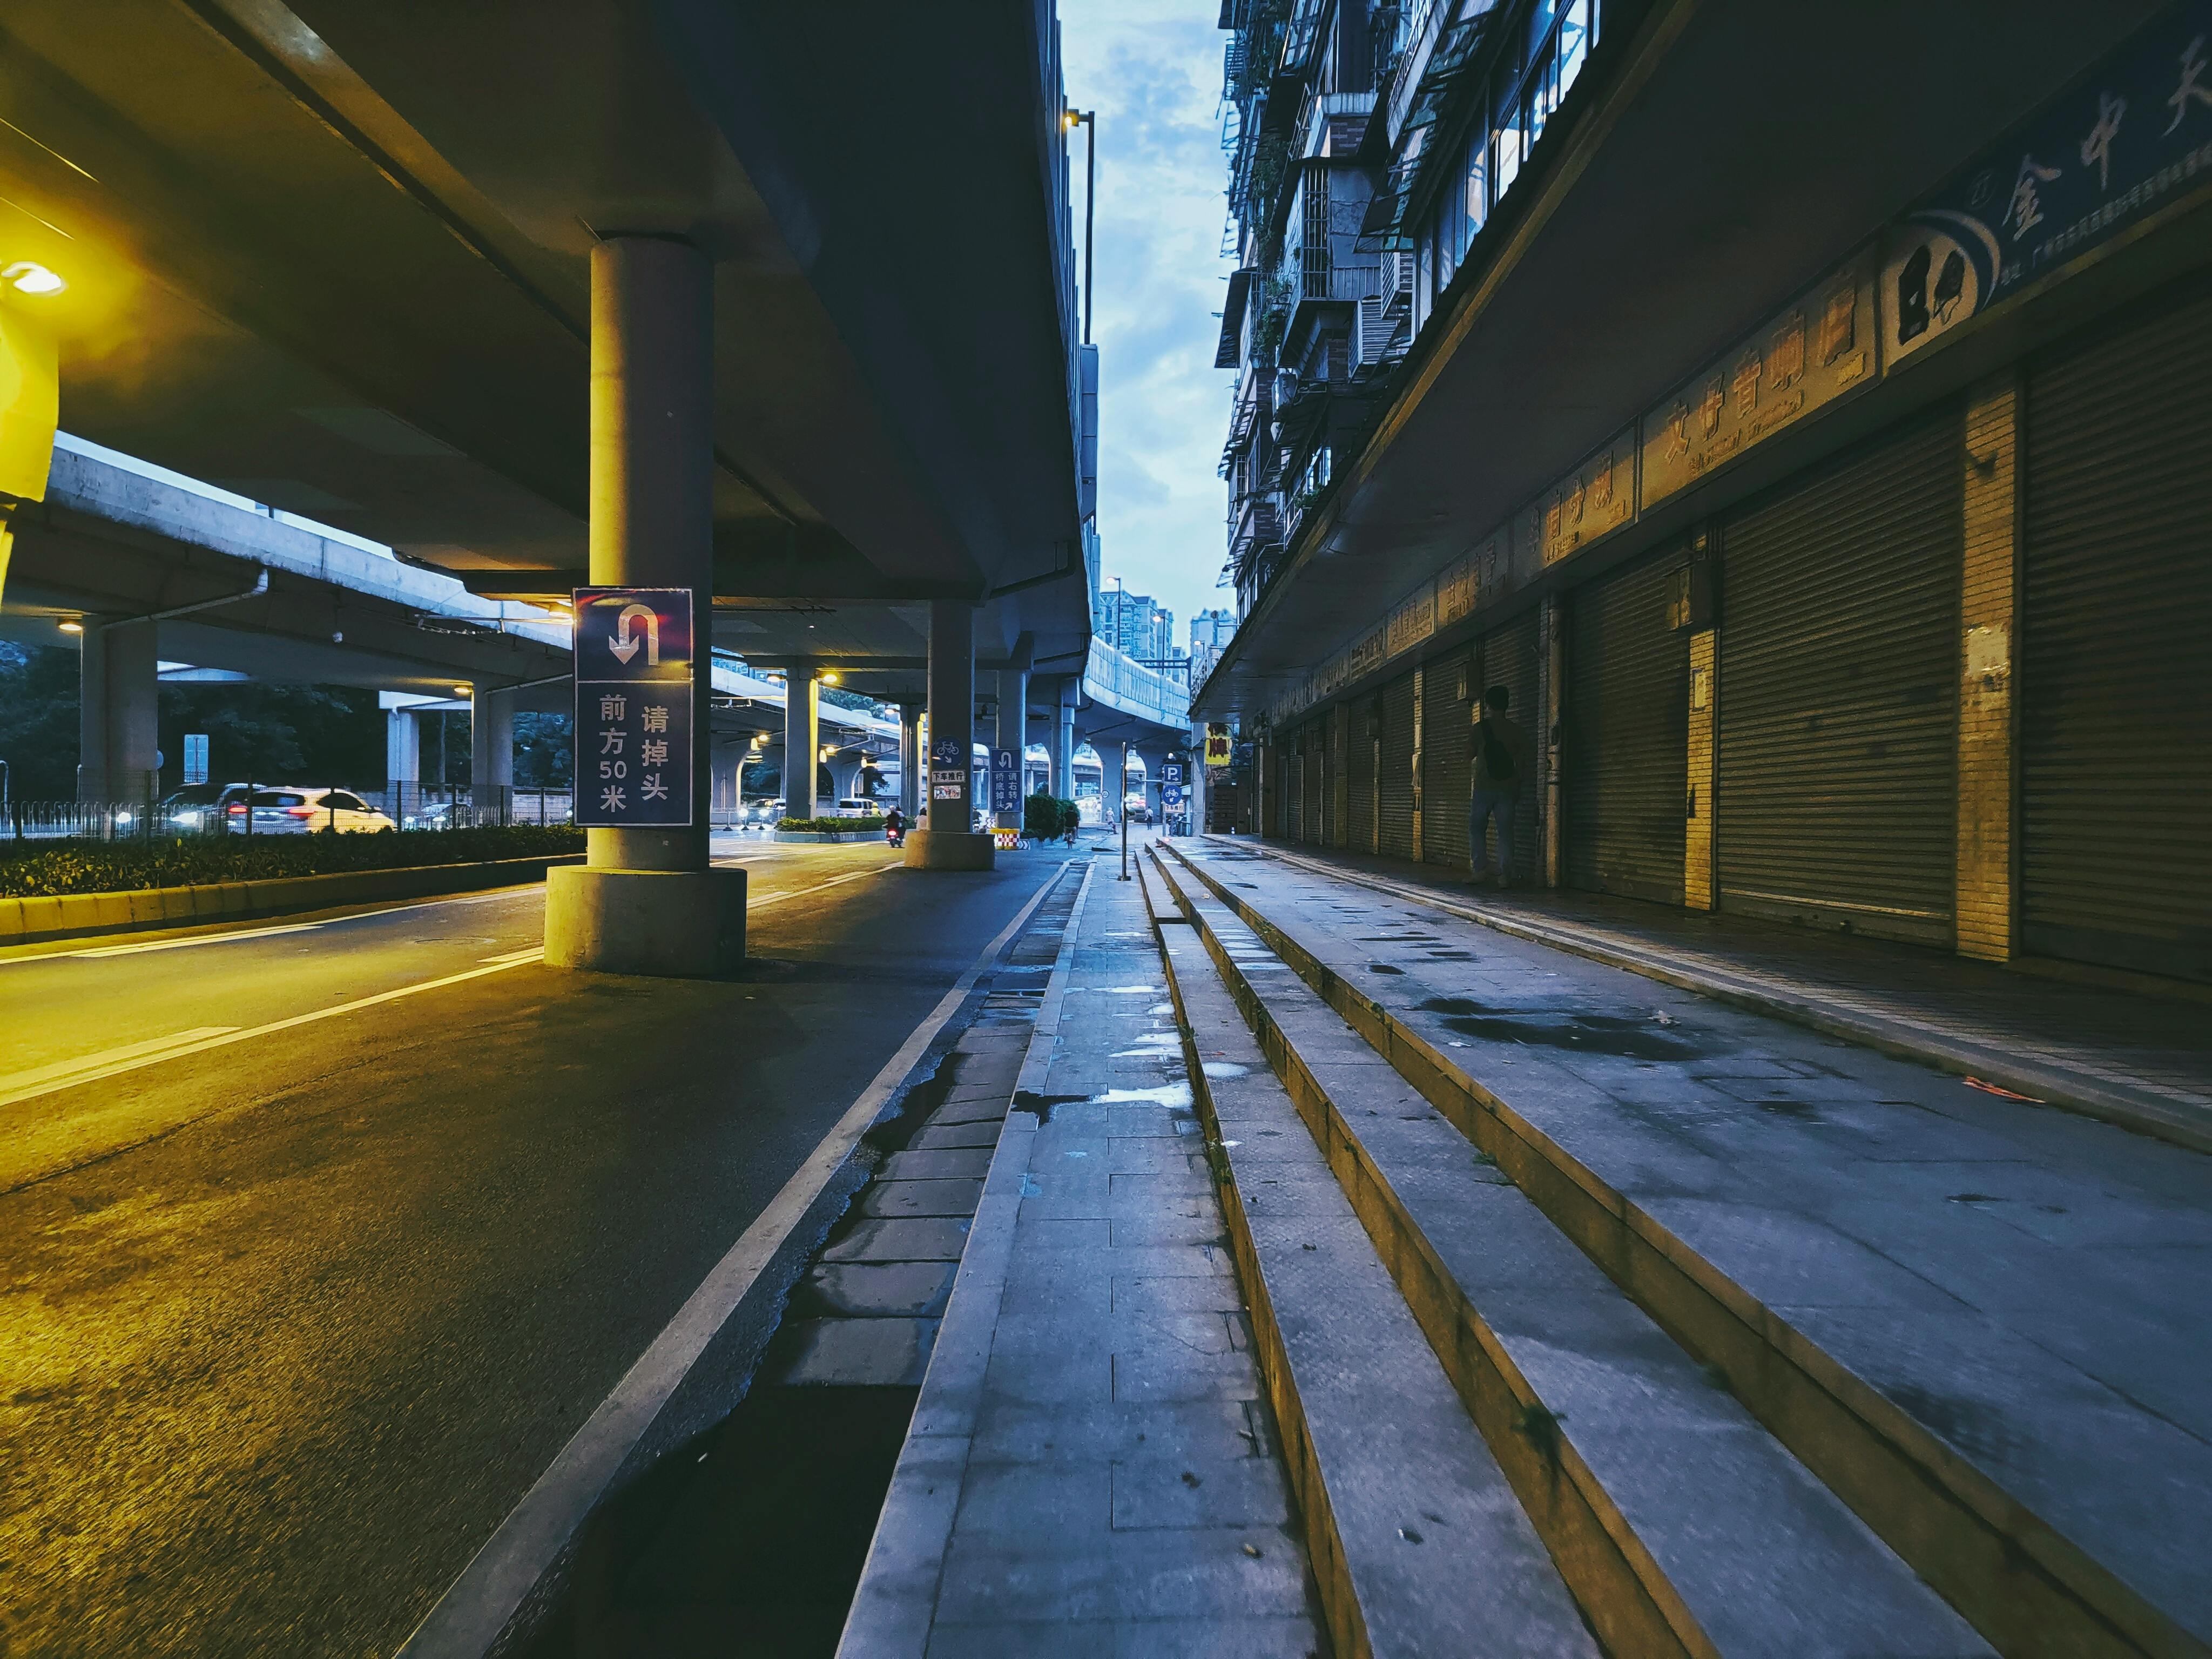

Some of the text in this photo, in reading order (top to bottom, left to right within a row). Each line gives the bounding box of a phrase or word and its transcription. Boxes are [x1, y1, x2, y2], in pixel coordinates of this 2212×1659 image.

[599, 694, 628, 813] 前方50米
[641, 705, 669, 801] 请掉头
[933, 772, 963, 781] 下车推行
[1008, 773, 1017, 799] 请右转
[1168, 767, 1178, 780] P
[995, 773, 1005, 808] 桥底掉头
